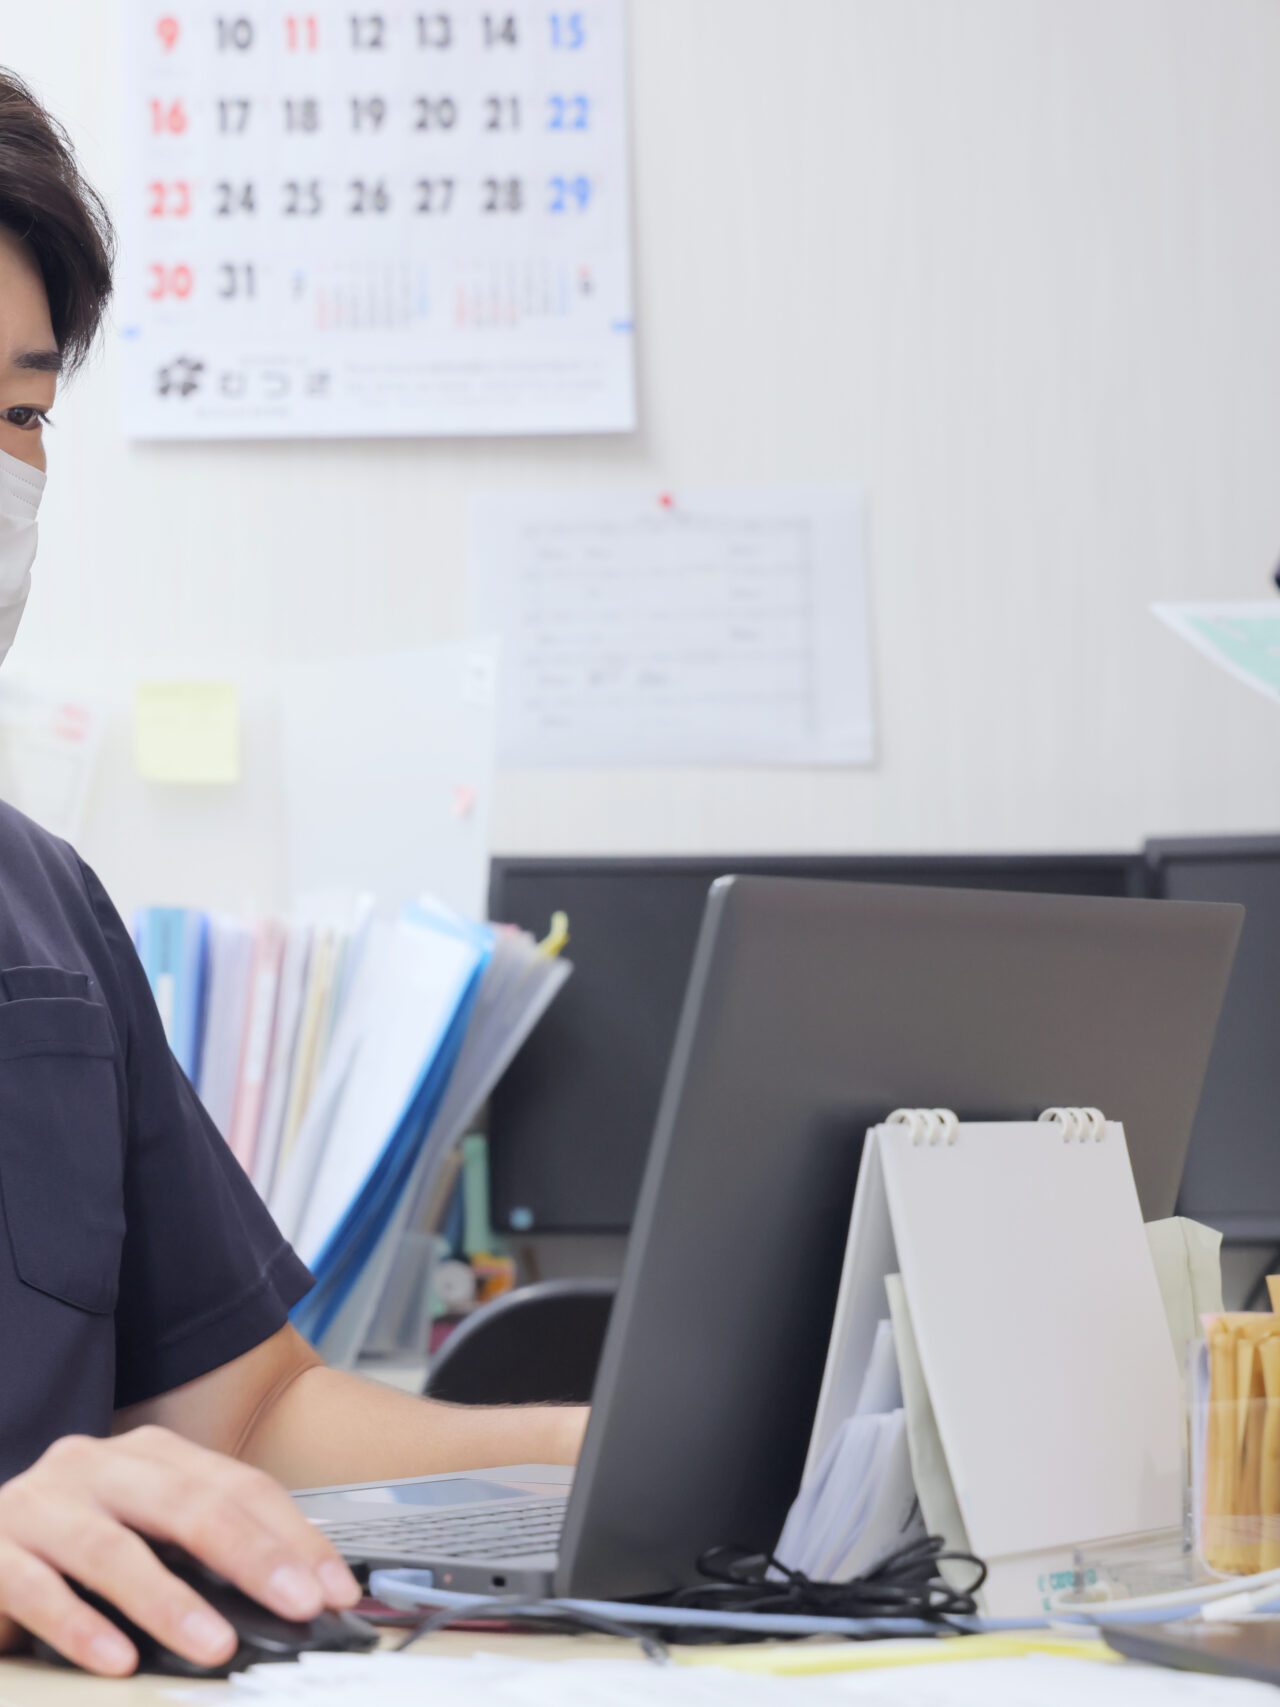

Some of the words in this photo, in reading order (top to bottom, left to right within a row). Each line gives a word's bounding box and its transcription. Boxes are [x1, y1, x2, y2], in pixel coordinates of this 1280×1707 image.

[156, 15, 181, 52] 9
[215, 15, 255, 52] 10
[285, 15, 319, 51] 11
[349, 14, 386, 51] 12
[415, 13, 454, 50] 13
[481, 13, 519, 49] 14
[548, 12, 586, 50] 15
[150, 98, 188, 136] 16
[217, 98, 252, 134] 17
[282, 96, 321, 134] 18
[349, 95, 388, 133] 19
[414, 95, 457, 132] 20
[485, 95, 522, 132] 21
[548, 94, 590, 132] 22
[148, 180, 191, 218] 23
[216, 180, 257, 217] 24
[283, 179, 323, 217] 25
[349, 178, 391, 216] 26
[416, 177, 455, 215] 27
[483, 176, 524, 214] 28
[548, 175, 593, 214] 29
[148, 262, 194, 301] 30
[218, 261, 257, 301] 31
